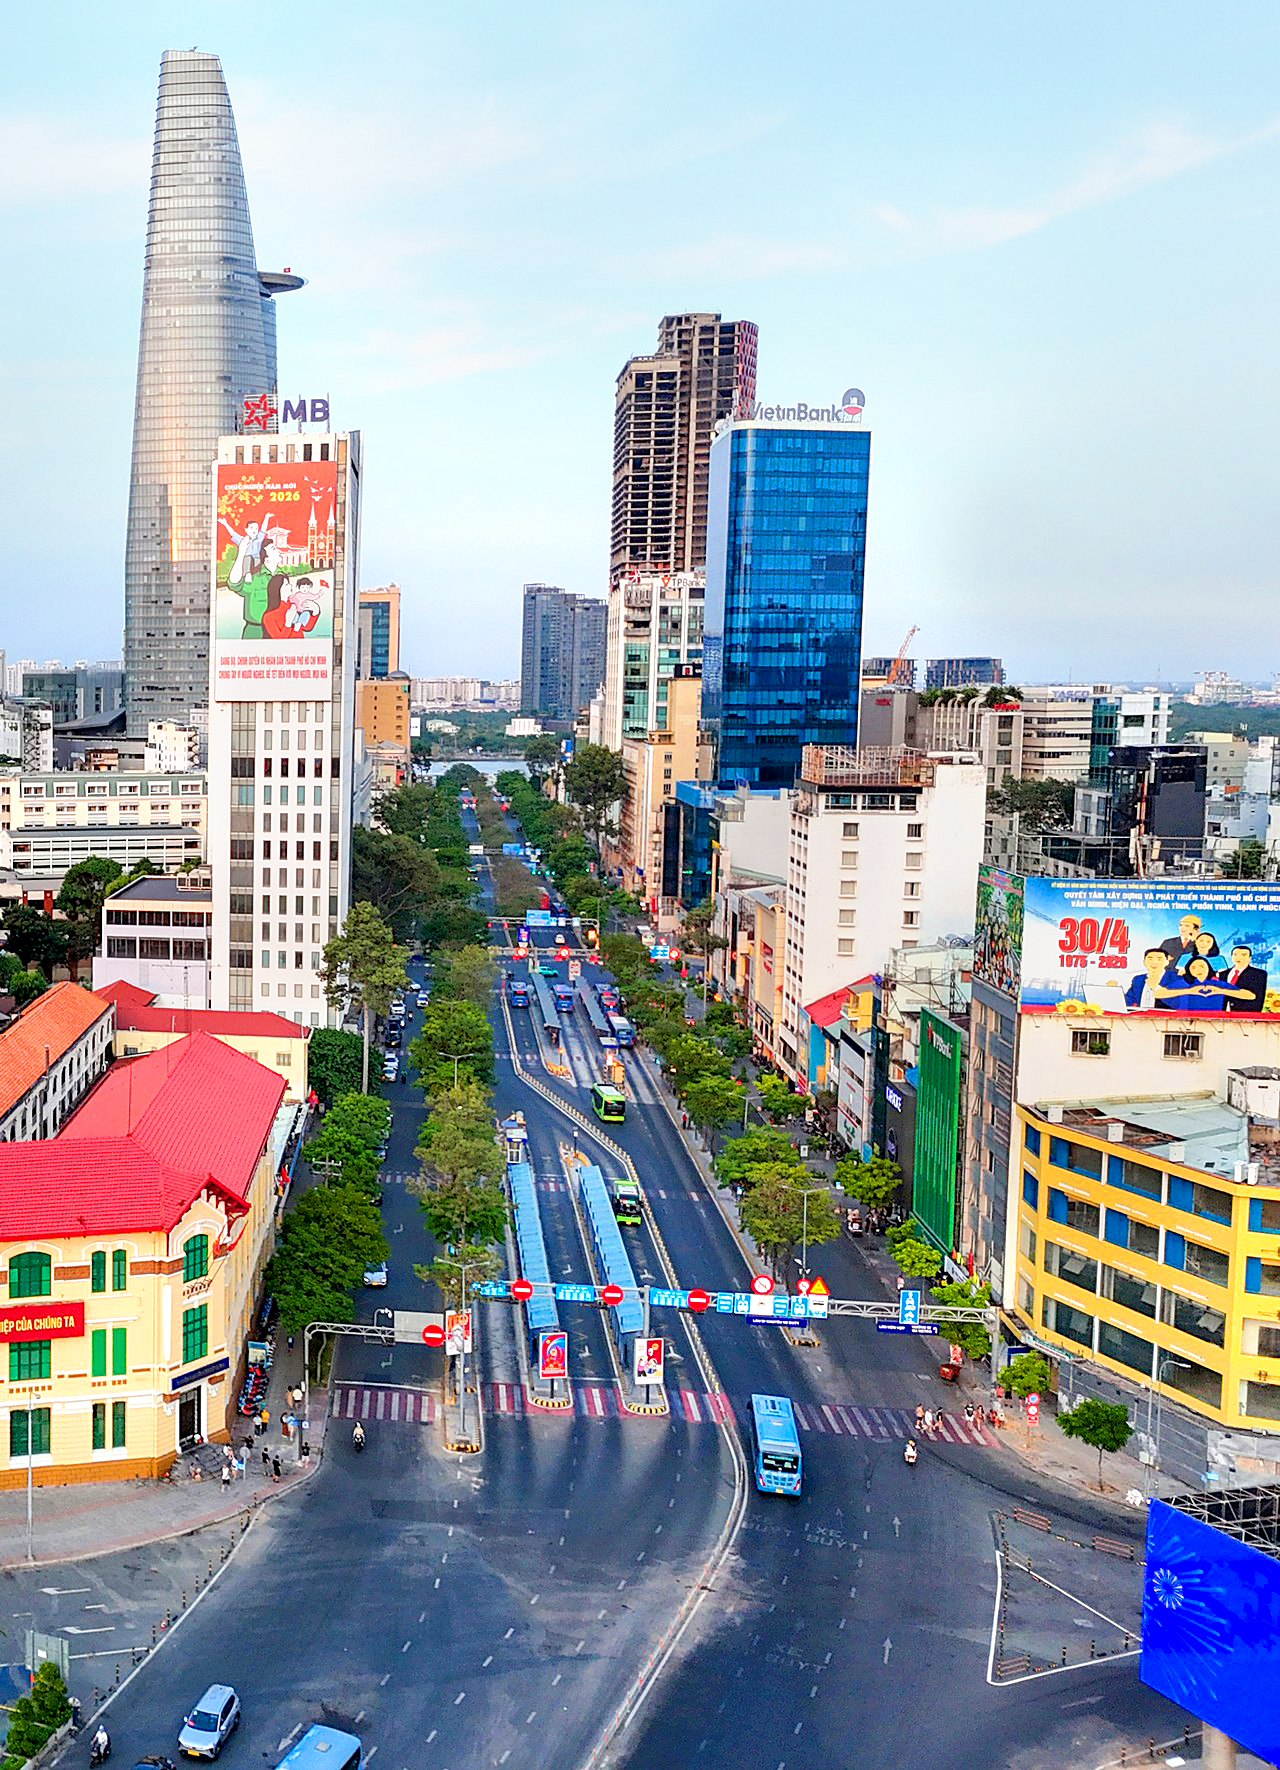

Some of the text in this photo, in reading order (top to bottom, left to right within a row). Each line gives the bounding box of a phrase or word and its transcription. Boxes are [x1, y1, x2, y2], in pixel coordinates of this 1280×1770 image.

[282, 399, 329, 423] MB
[269, 491, 300, 502] 2026
[672, 578, 700, 587] TPBank
[1052, 690, 1089, 698] TASCO
[1064, 891, 1087, 899] QUYẾT
[1089, 891, 1104, 899] TÂM
[1106, 891, 1120, 899] XÂY
[1144, 892, 1154, 900] VÀ
[1156, 892, 1177, 900] PHÁT
[1177, 891, 1198, 900] TRIỂN
[1200, 893, 1224, 901] THÀNH
[1226, 893, 1241, 901] PHỐ
[1255, 894, 1267, 902] CHÍ
[1236, 904, 1257, 912] HẠNH
[1058, 917, 1130, 954] 30/4
[16, 1316, 33, 1332] CỦA
[34, 1315, 62, 1331] CHÚNG
[63, 1316, 75, 1328] TA
[817, 1526, 842, 1538] XE
